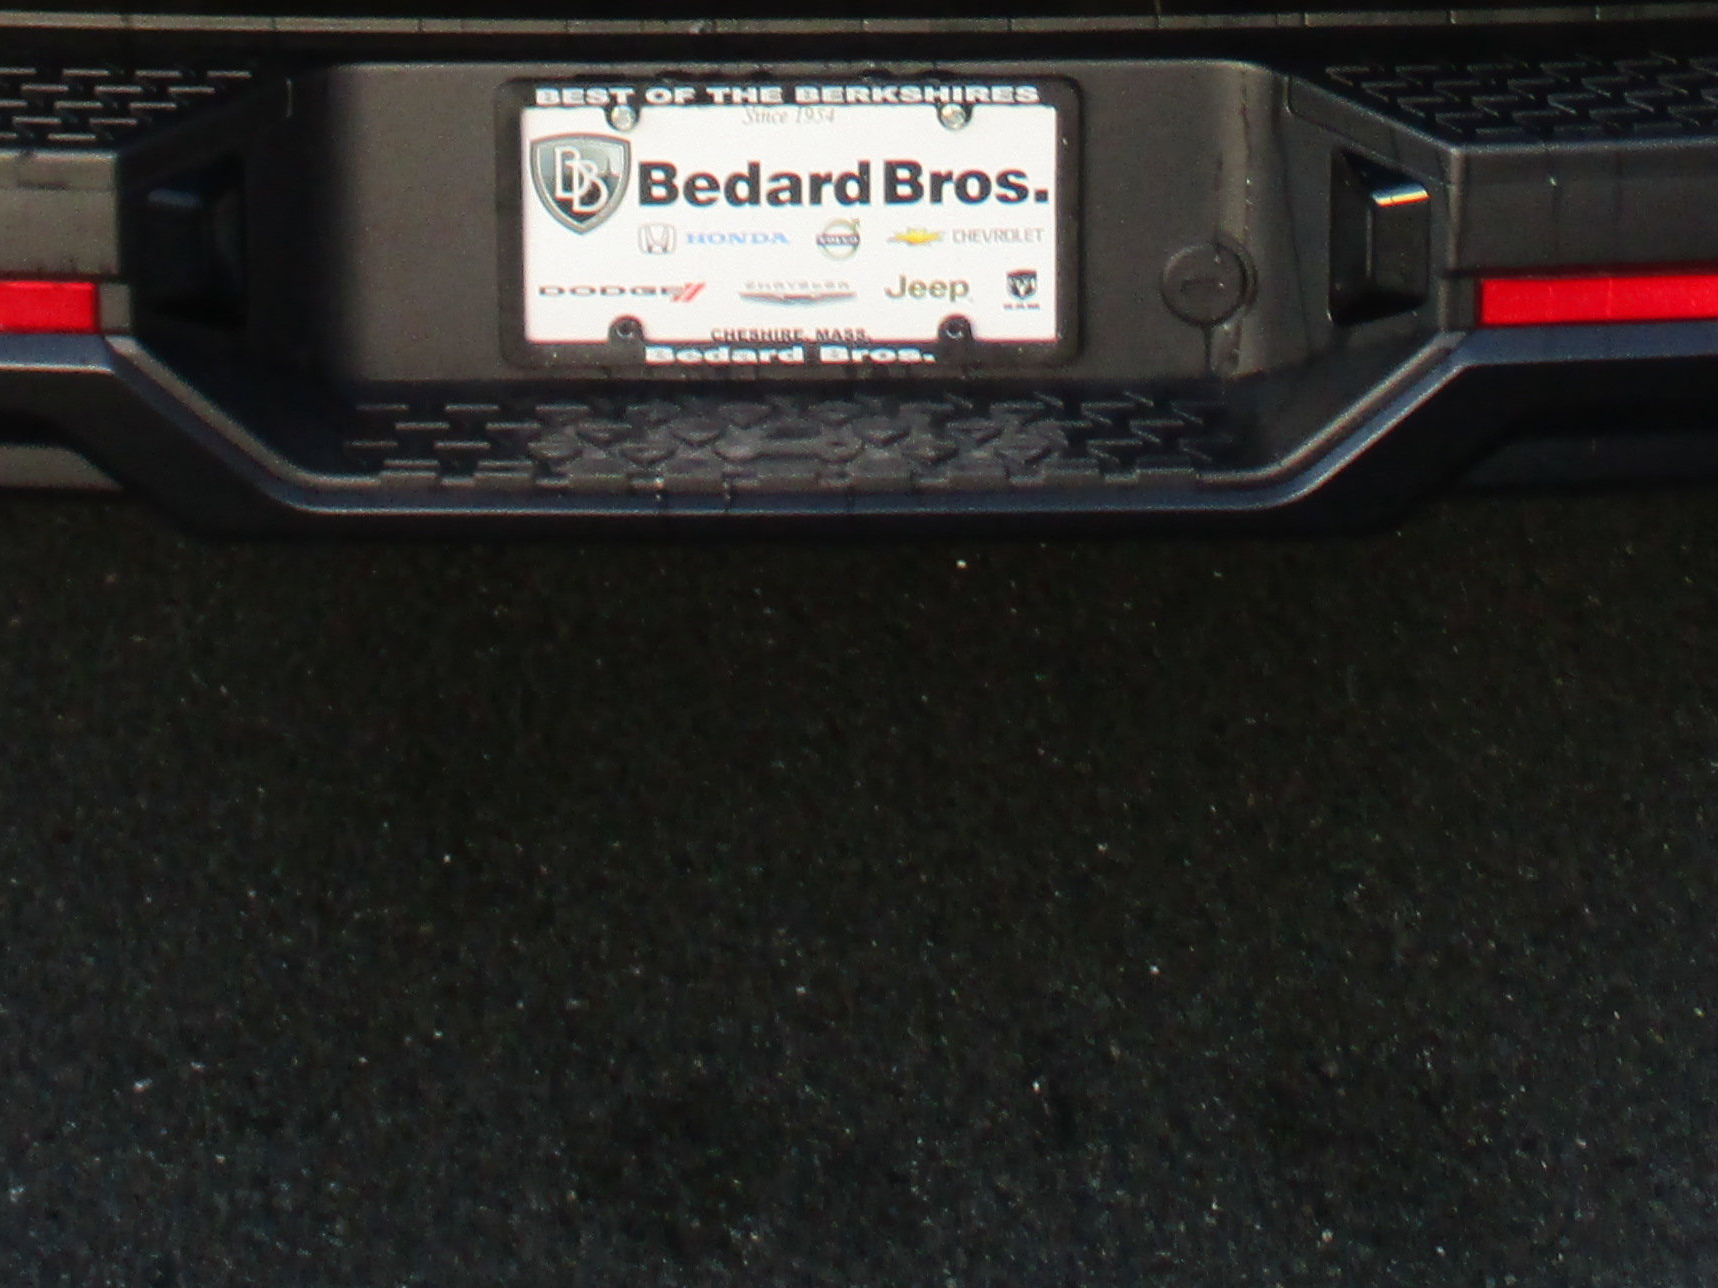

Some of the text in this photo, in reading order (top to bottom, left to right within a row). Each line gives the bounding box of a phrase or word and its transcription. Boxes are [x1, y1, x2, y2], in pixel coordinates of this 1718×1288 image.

[535, 85, 1040, 106] BEST OF THE BERKSHIRES
[743, 105, 787, 125] Since
[638, 159, 1049, 207] Bedard Bros.
[686, 232, 790, 246] HONDA
[953, 227, 1045, 244] CHEVROLET
[539, 284, 684, 297] DODGE
[885, 274, 970, 301] Jeep
[645, 343, 936, 365] Bedard Bros.
